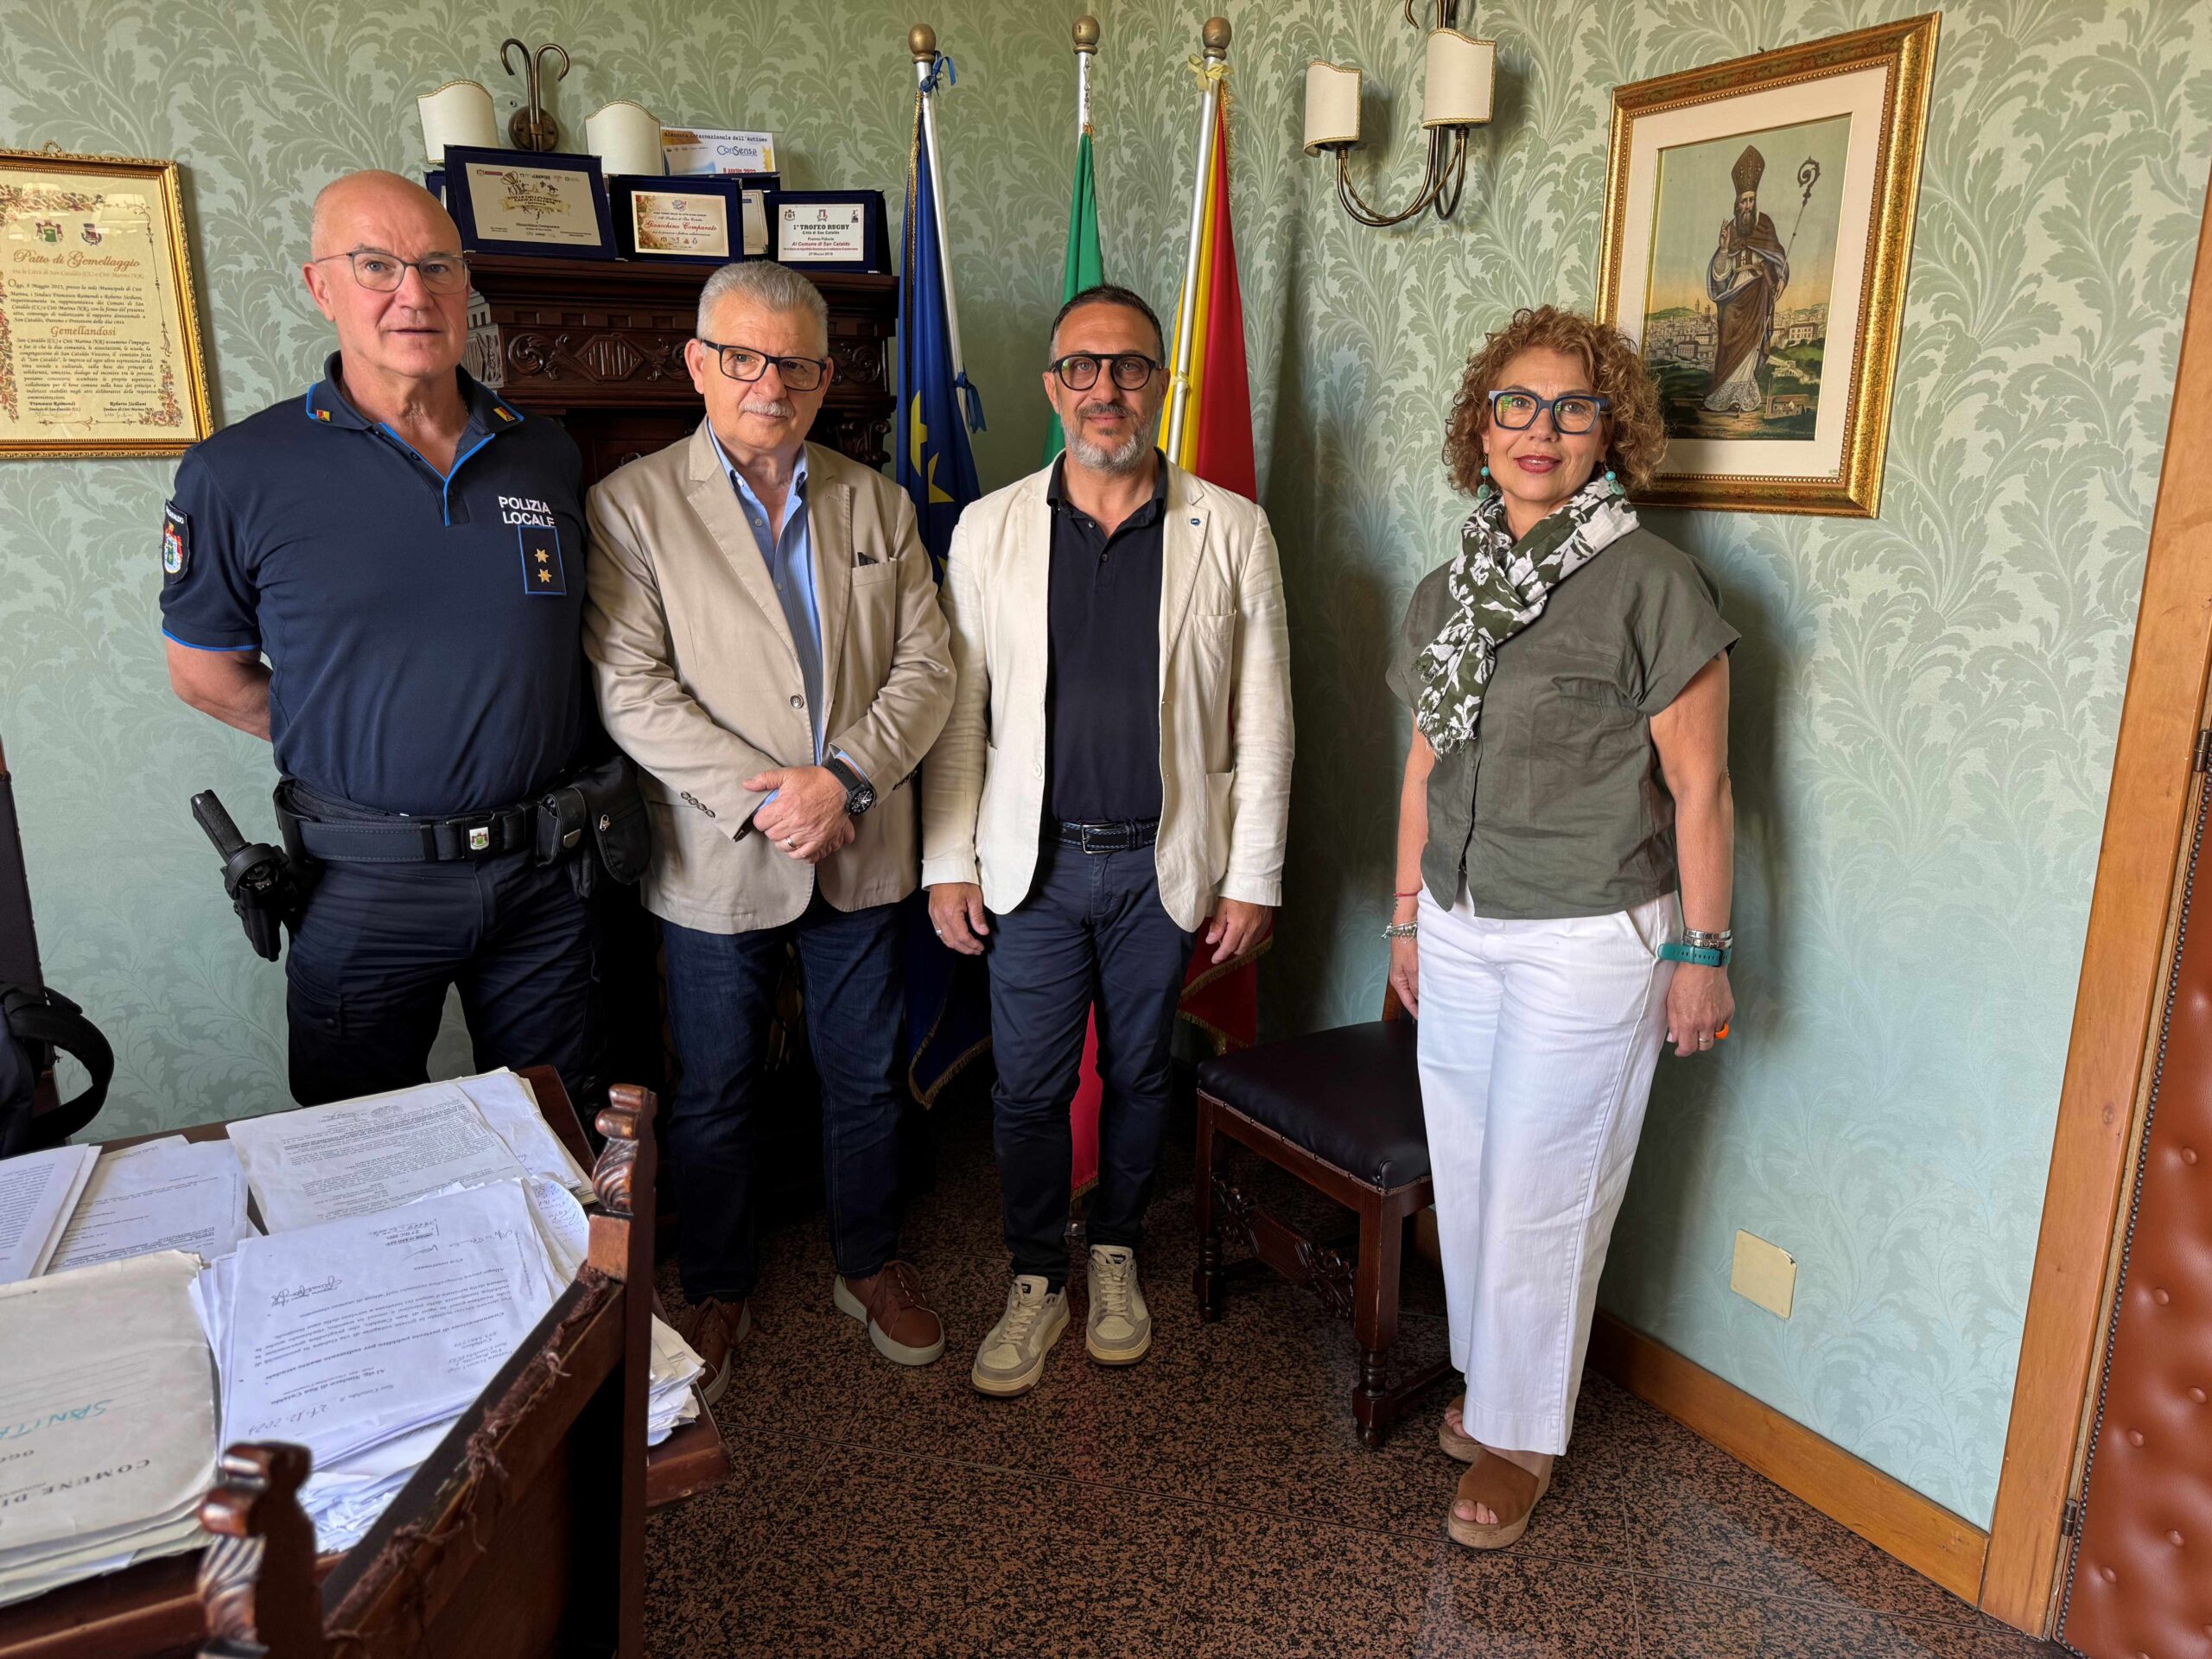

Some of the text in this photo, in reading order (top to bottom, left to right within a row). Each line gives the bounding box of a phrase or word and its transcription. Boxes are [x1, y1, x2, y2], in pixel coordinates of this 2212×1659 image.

[644, 220, 717, 232] Gioacchino Comparato
[14, 249, 141, 272] Patto di Gemellaggio
[50, 326, 116, 337] Gemellandosi
[498, 496, 551, 515] POLIZIA
[502, 511, 555, 526] LOCALE
[329, 1375, 359, 1386] Sindaco
[270, 1392, 302, 1405] Cataldo
[41, 1459, 151, 1496] COMUNE
[1, 1493, 28, 1507] DI
